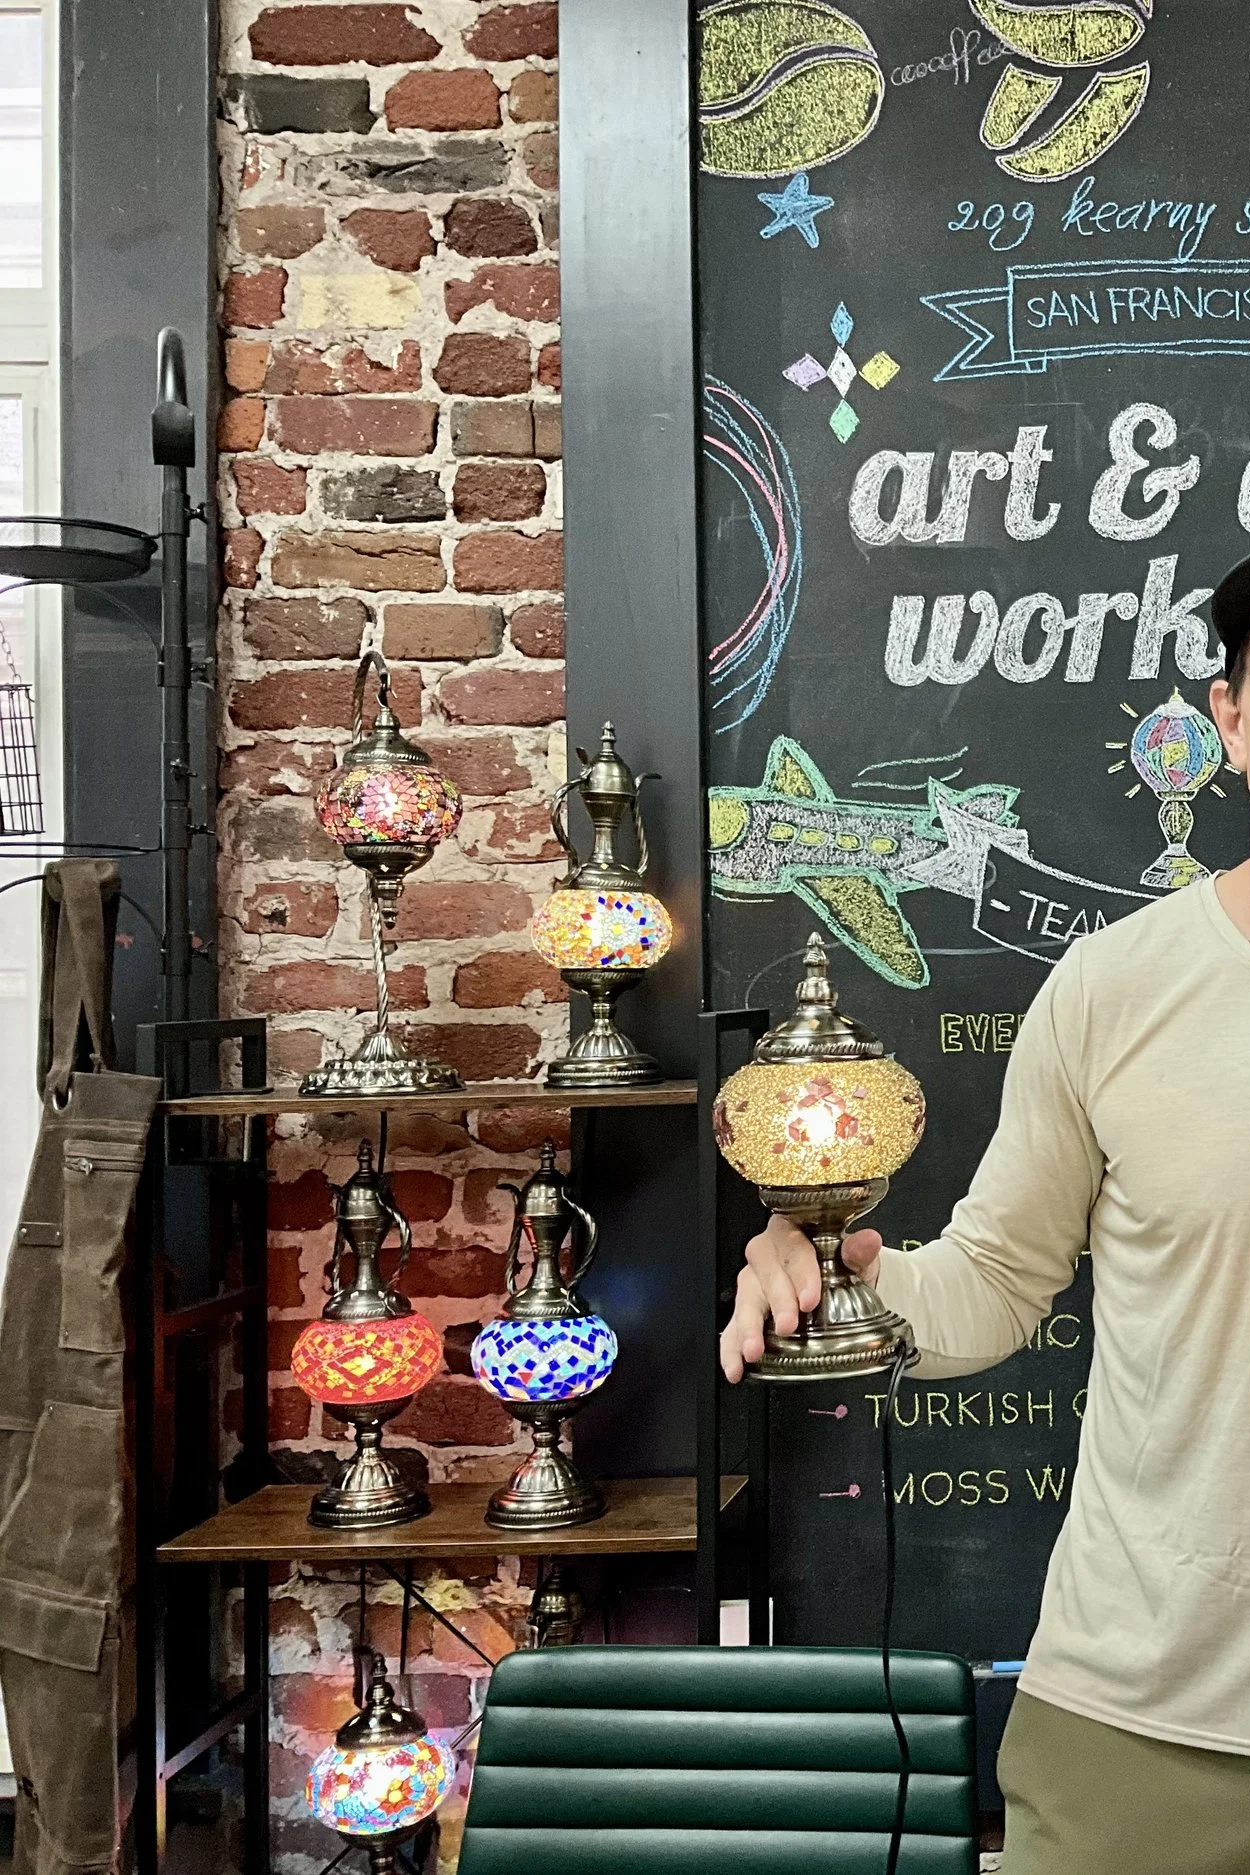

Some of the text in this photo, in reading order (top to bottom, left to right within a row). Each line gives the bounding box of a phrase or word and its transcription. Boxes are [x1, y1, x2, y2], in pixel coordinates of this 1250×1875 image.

[947, 201, 1035, 251] 209
[1061, 176, 1217, 261] kearny
[1026, 291, 1100, 327] SAN
[849, 425, 1062, 546] art
[1088, 402, 1201, 542] &
[940, 1012, 1027, 1054] EVE
[864, 1389, 1053, 1429] TURKISH
[881, 1469, 1009, 1506] MOSS
